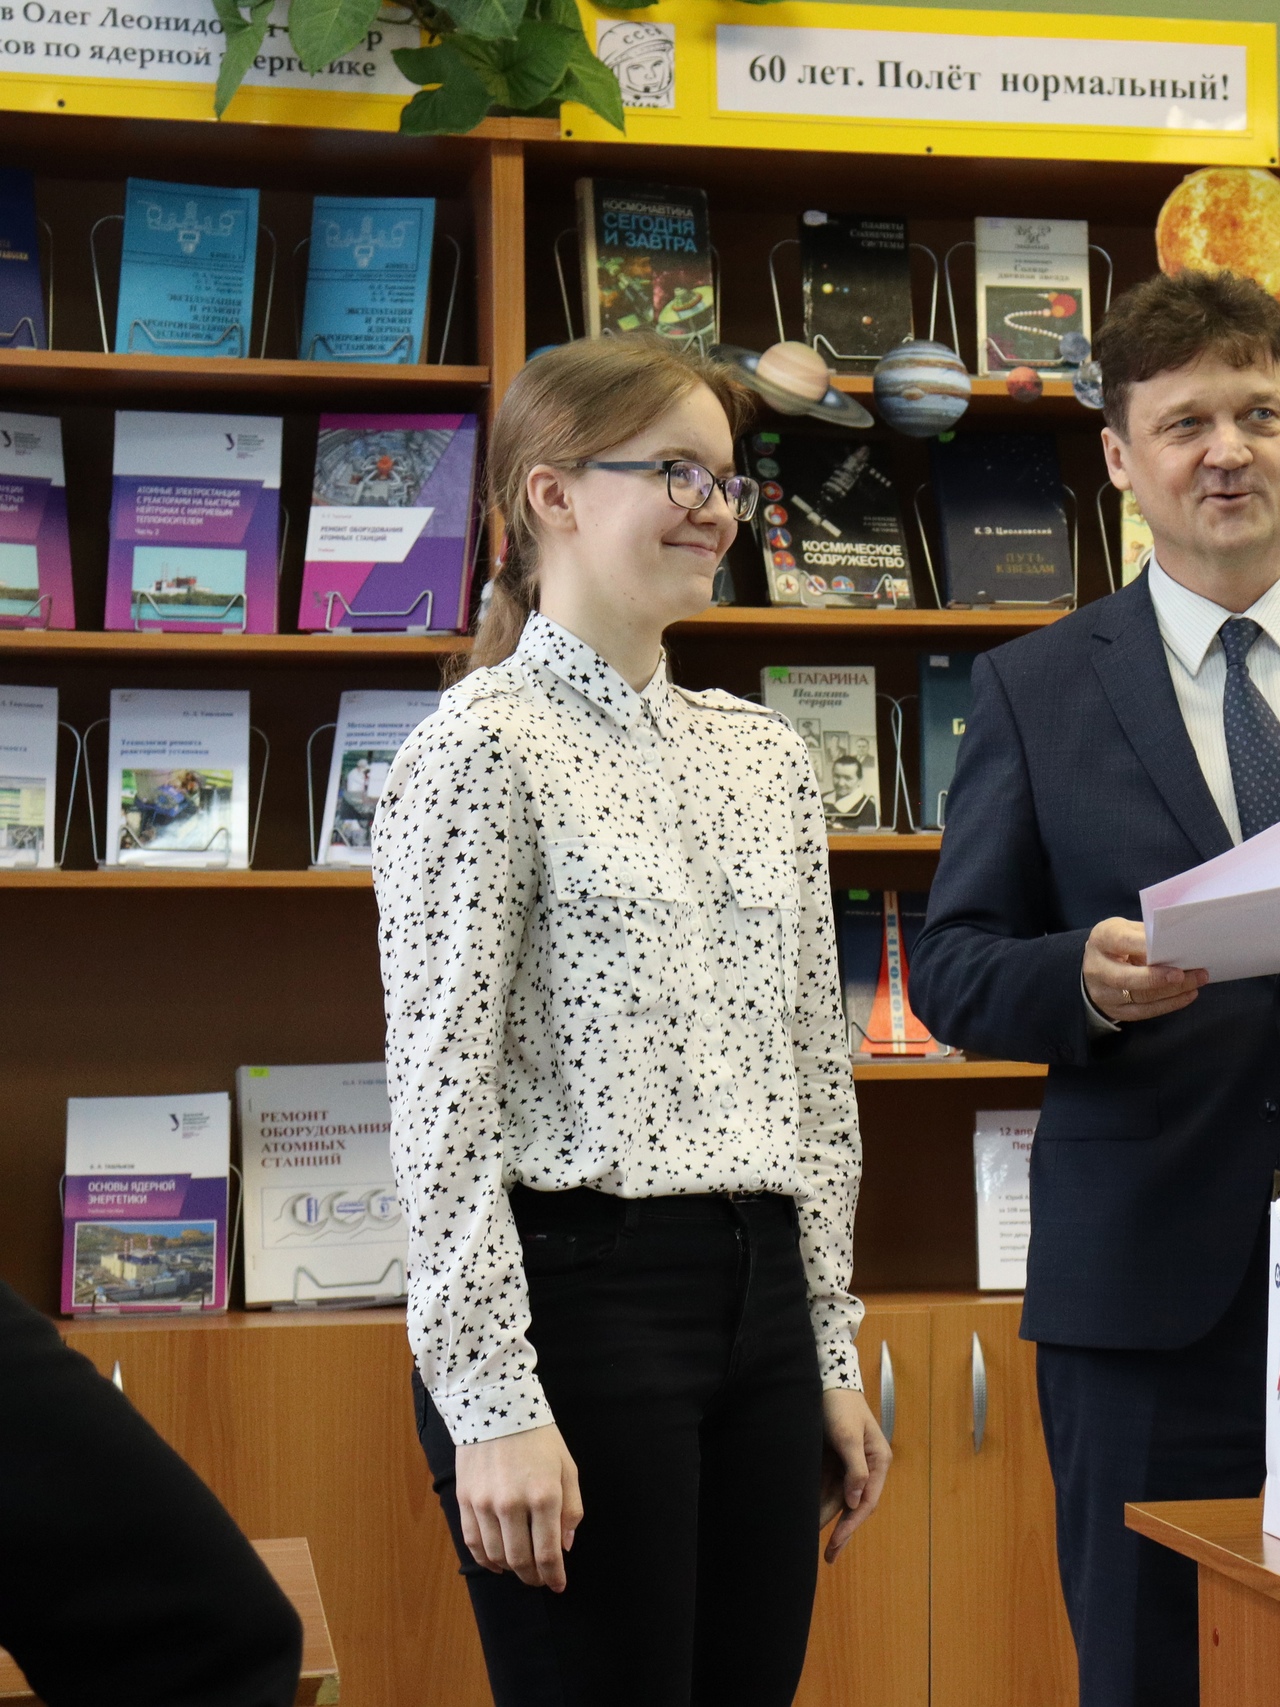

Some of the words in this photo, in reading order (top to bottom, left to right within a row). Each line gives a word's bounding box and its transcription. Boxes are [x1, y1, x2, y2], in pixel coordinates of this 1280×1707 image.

[23, 2, 91, 26] Олег
[44, 42, 81, 59] по
[89, 44, 212, 69] ядерной
[749, 54, 787, 84] 60
[797, 58, 864, 88] лет.
[876, 60, 981, 92] Полёт
[1001, 70, 1230, 104] нормальный!
[603, 199, 694, 217] КОСМОНАВТИКА
[603, 212, 695, 236] СЕГОДНЯ
[604, 230, 619, 246] И
[625, 231, 698, 253] ЗАВТРА
[802, 540, 903, 556] КОСМИЧЕСКОЕ
[804, 552, 906, 569] СОДРУЖЕСТВО
[261, 1110, 329, 1123] РЕМОНТ
[261, 1122, 392, 1139] ОБОРУДОВАНИЯ
[1000, 1127, 1011, 1136] 12
[261, 1139, 346, 1153] АТОМНЫХ
[261, 1153, 342, 1168] СТАНЦИЙ
[88, 1181, 128, 1192] ОСНОВЫ
[131, 1179, 176, 1193] ЯДЕРНОЙ
[88, 1194, 148, 1205] ЭНЕРГЕТИКИ
